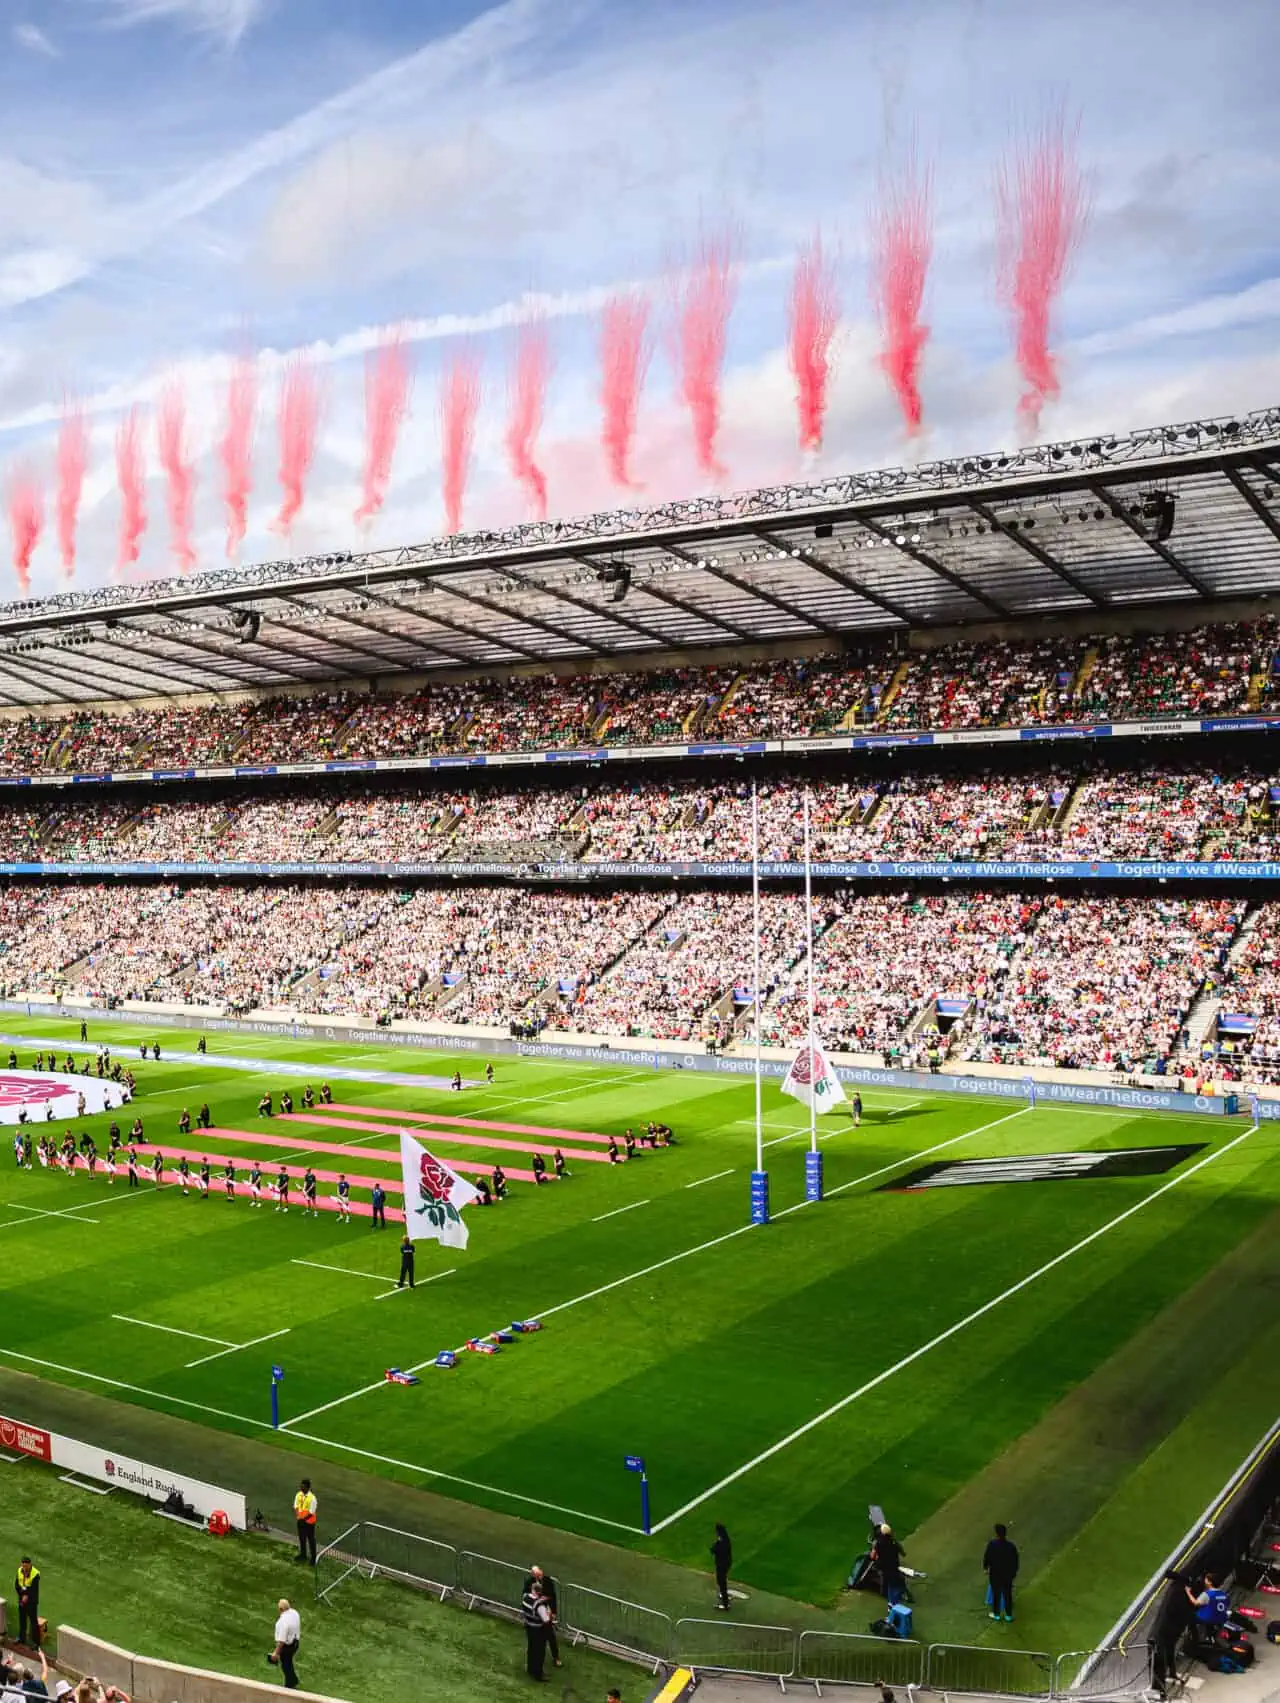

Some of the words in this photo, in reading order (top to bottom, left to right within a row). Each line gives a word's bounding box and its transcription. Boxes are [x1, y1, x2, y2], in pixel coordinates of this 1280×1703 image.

[394, 863, 432, 874] Together
[448, 863, 512, 872] #WearTheRose
[598, 863, 672, 873] #WearTheRose
[702, 863, 751, 875] Together
[773, 863, 857, 873] #WeaTheRose
[892, 863, 948, 876] Together
[952, 866, 971, 874] we
[975, 863, 1074, 874] #WearTheRose
[1115, 864, 1182, 877] Together
[1186, 866, 1209, 875] we
[348, 1029, 388, 1043] Together
[389, 1034, 404, 1042] we
[406, 1033, 478, 1048] #WearTheRose
[516, 1042, 563, 1057] Together
[568, 1048, 583, 1056] we
[952, 1077, 1018, 1095] Together
[1050, 1087, 1171, 1107] #WearTheRose
[117, 1467, 154, 1488] England
